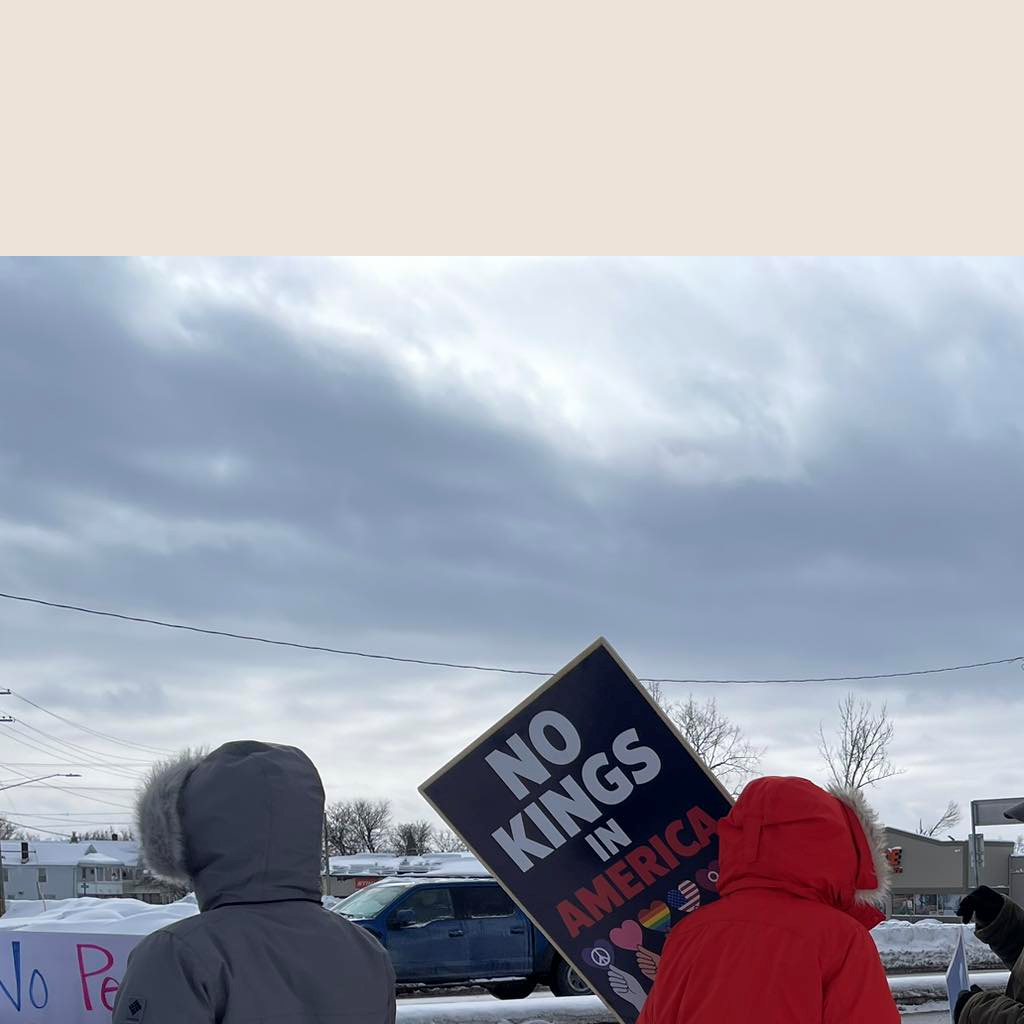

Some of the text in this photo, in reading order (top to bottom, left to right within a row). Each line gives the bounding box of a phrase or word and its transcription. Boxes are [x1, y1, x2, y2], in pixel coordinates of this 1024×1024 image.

[484, 710, 582, 801] NO
[491, 727, 662, 873] KINGS
[555, 805, 719, 938] AMERICA
[584, 817, 632, 862] IN
